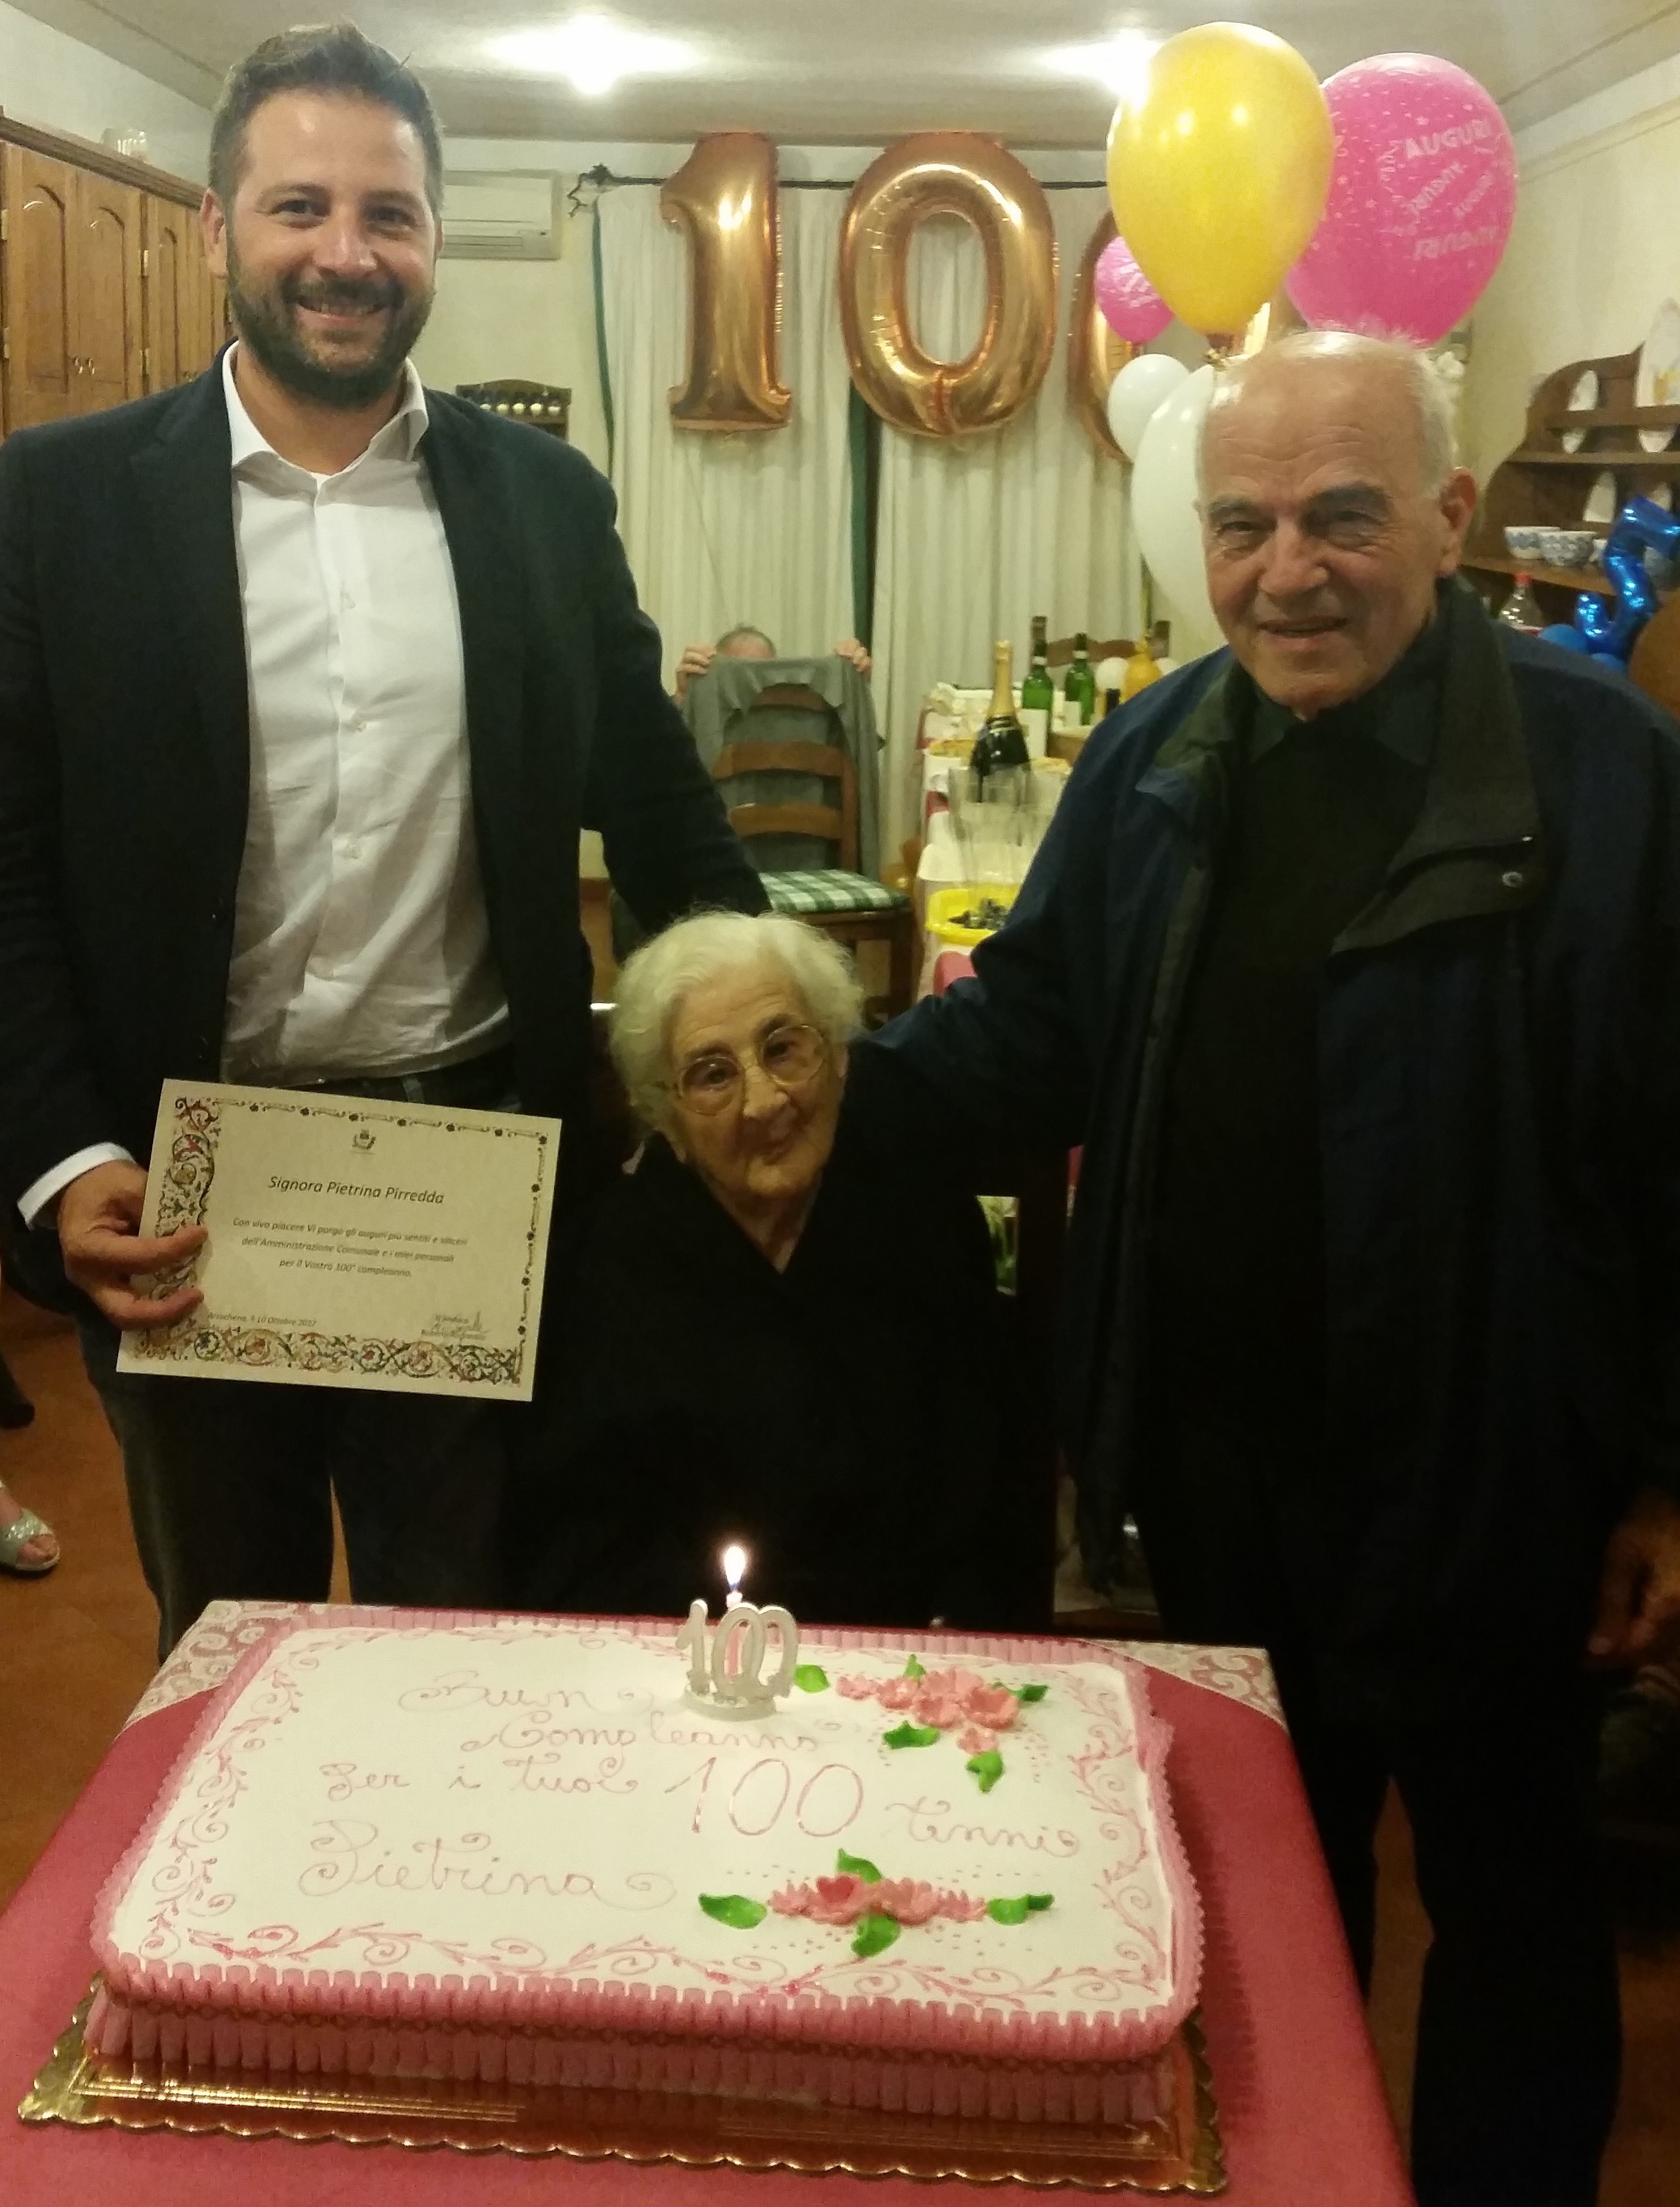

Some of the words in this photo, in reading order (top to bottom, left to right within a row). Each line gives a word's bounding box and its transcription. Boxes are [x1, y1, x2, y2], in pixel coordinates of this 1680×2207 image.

[268, 1176, 322, 1192] Signora
[326, 1181, 381, 1198] Pietrina
[385, 1187, 444, 1204] Pirredda
[233, 1218, 249, 1226] Con
[253, 1220, 270, 1229] vivo
[271, 1221, 305, 1231] piacere
[317, 1226, 344, 1237] porgo
[357, 1230, 388, 1240] auguri
[279, 1259, 295, 1268] per
[305, 1259, 333, 1271] Vostro
[675, 1599, 800, 1698] 100
[664, 1757, 864, 1838] 100
[298, 1819, 678, 1911] Pietrina
